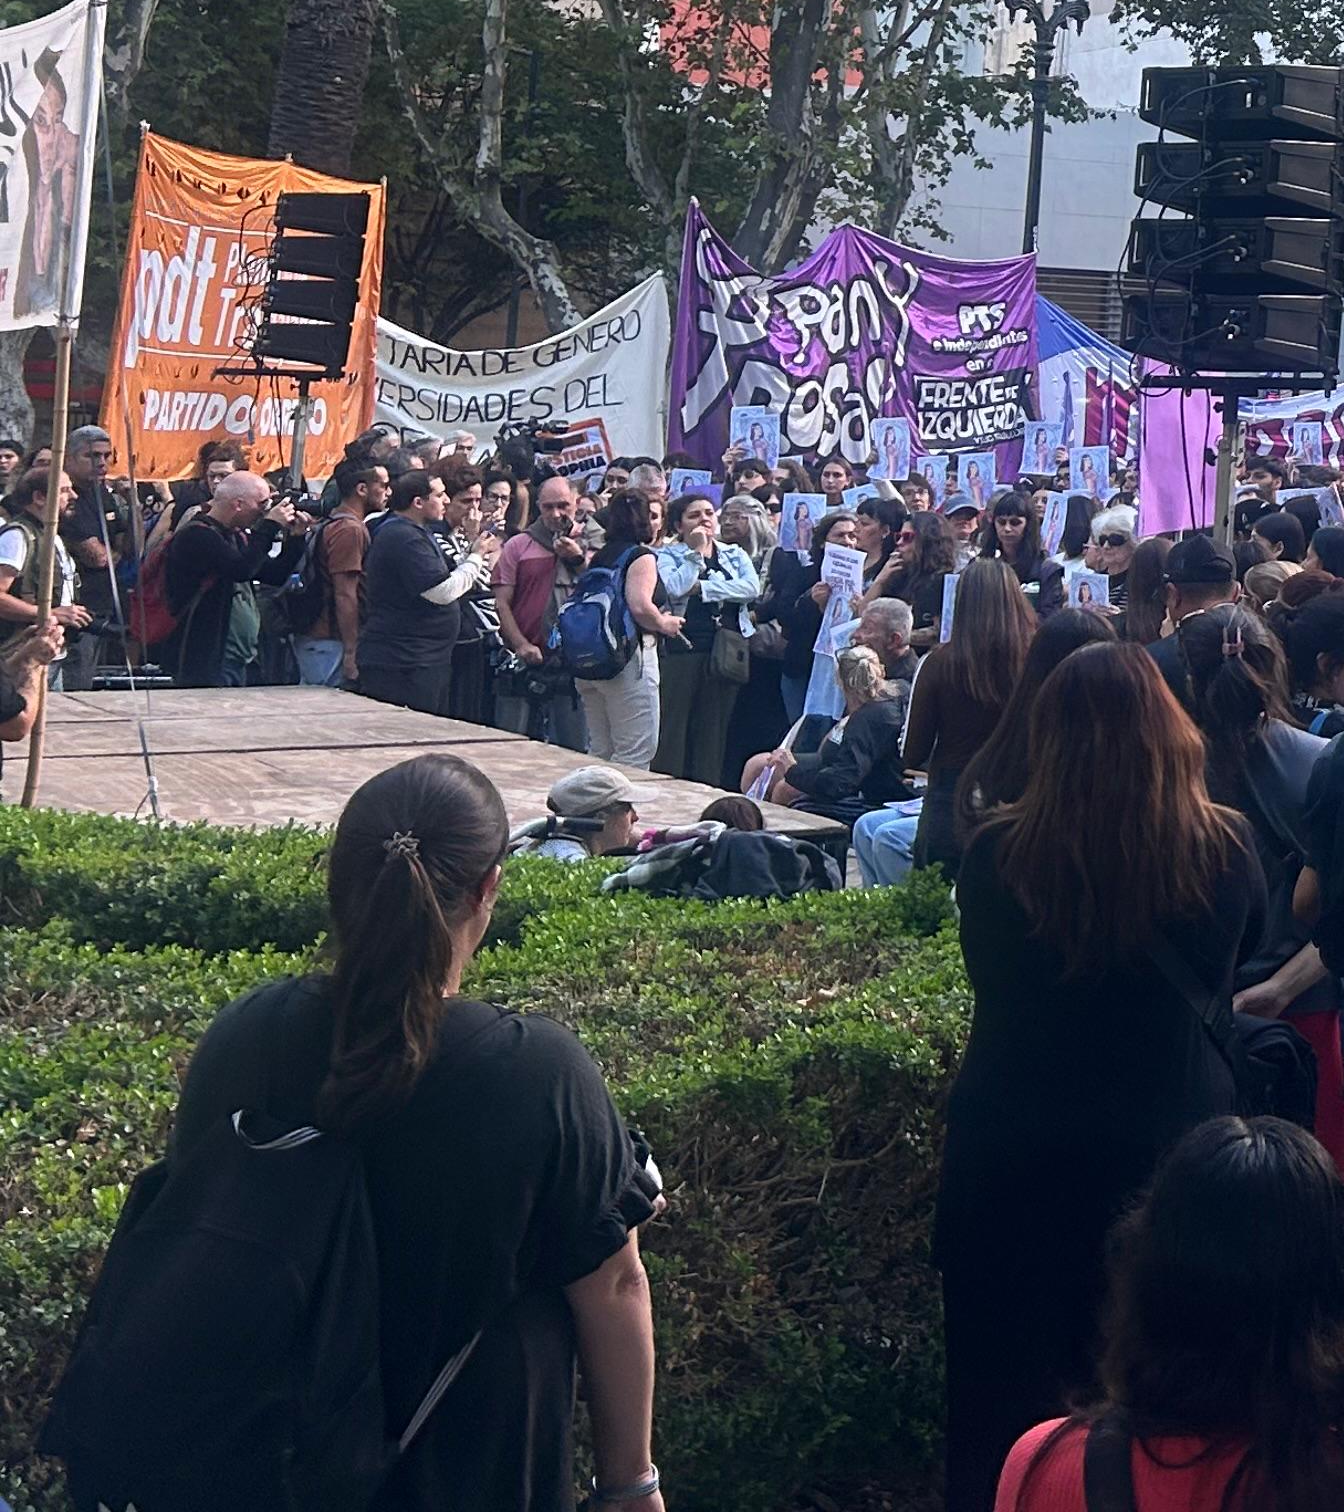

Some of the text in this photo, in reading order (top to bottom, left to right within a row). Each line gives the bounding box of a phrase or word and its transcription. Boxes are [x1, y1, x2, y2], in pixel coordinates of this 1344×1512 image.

[125, 226, 217, 368] pdt
[958, 302, 1006, 334] PTS
[385, 308, 643, 377] TARIA DE GENERO
[375, 373, 625, 423] ERSIDADES DEL
[918, 375, 1006, 409] FRENTE
[142, 390, 328, 438] PARTIDO OBREO
[917, 401, 1026, 441] IZQUIERDA
[551, 444, 603, 466] STICIA
[556, 455, 607, 477] OPHIA
